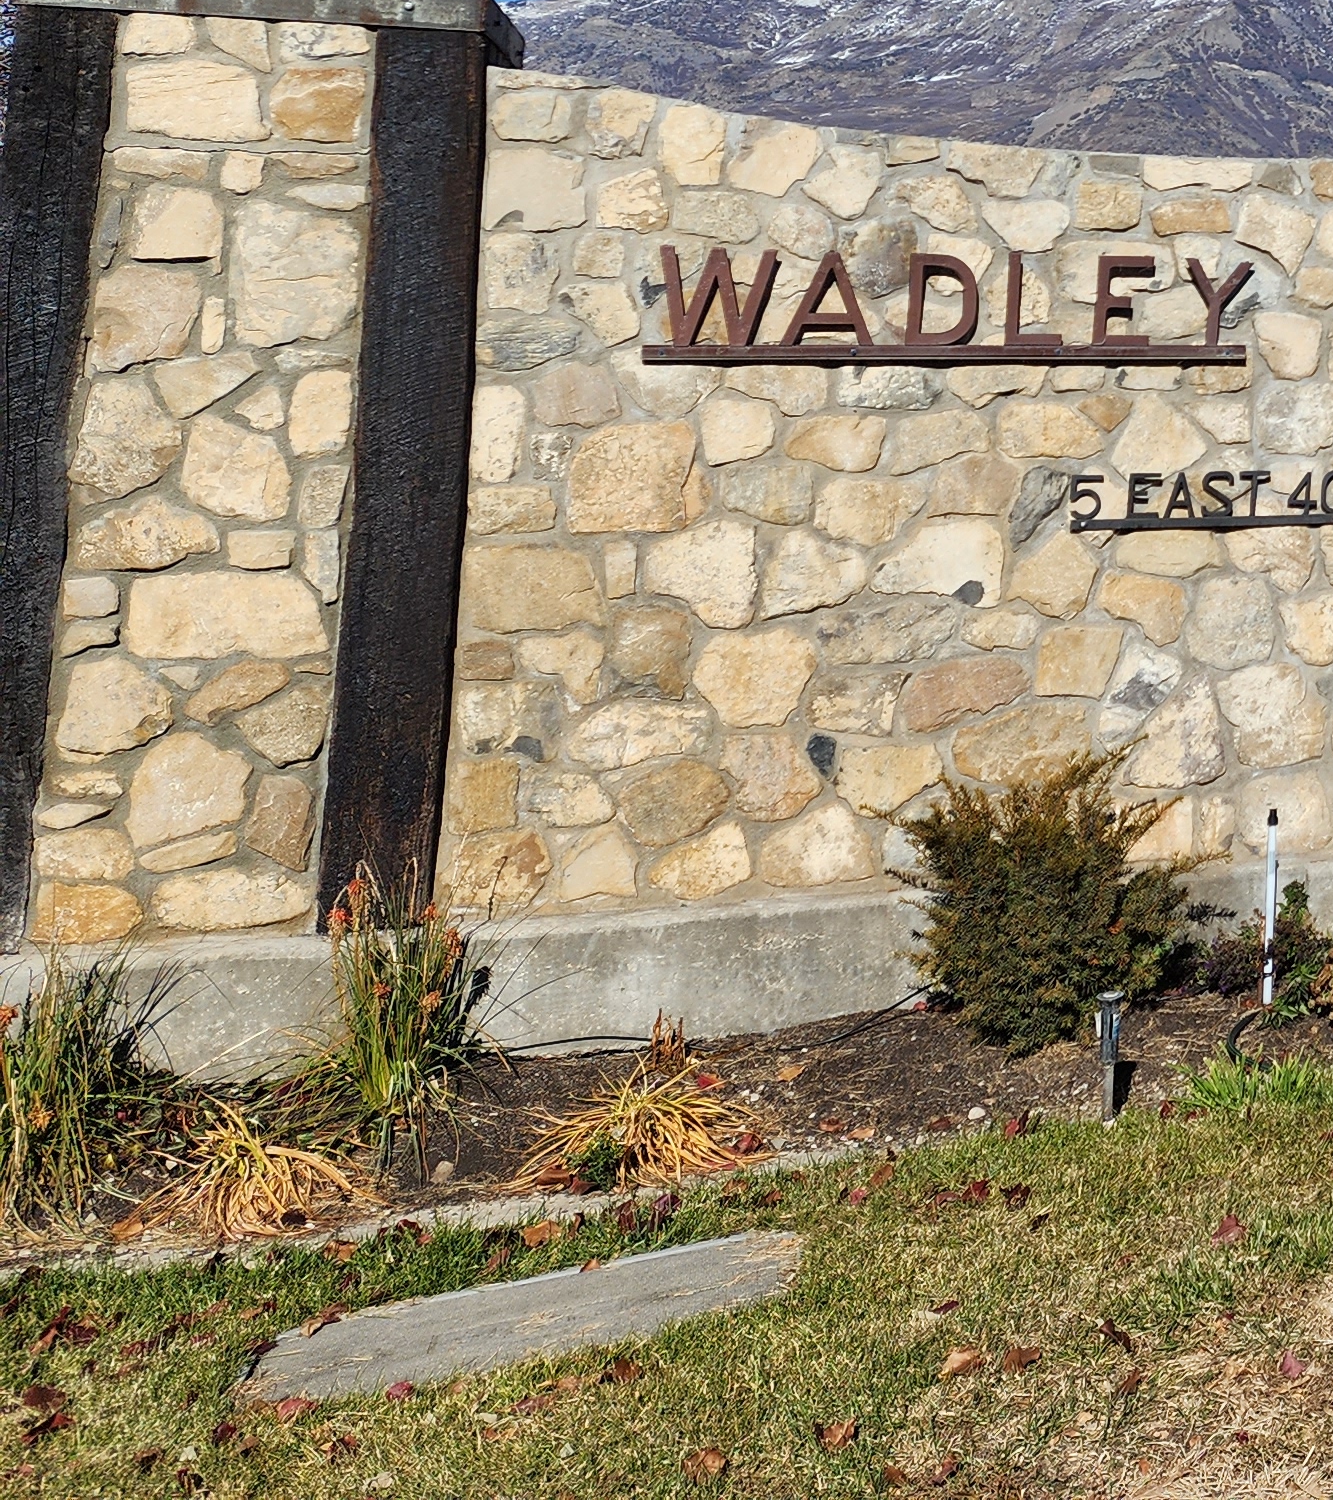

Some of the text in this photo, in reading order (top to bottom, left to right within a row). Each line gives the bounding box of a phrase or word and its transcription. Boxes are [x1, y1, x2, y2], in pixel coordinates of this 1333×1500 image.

[659, 245, 1255, 347] WADLEY
[1069, 474, 1101, 520] 5
[1126, 471, 1271, 519] EAST
